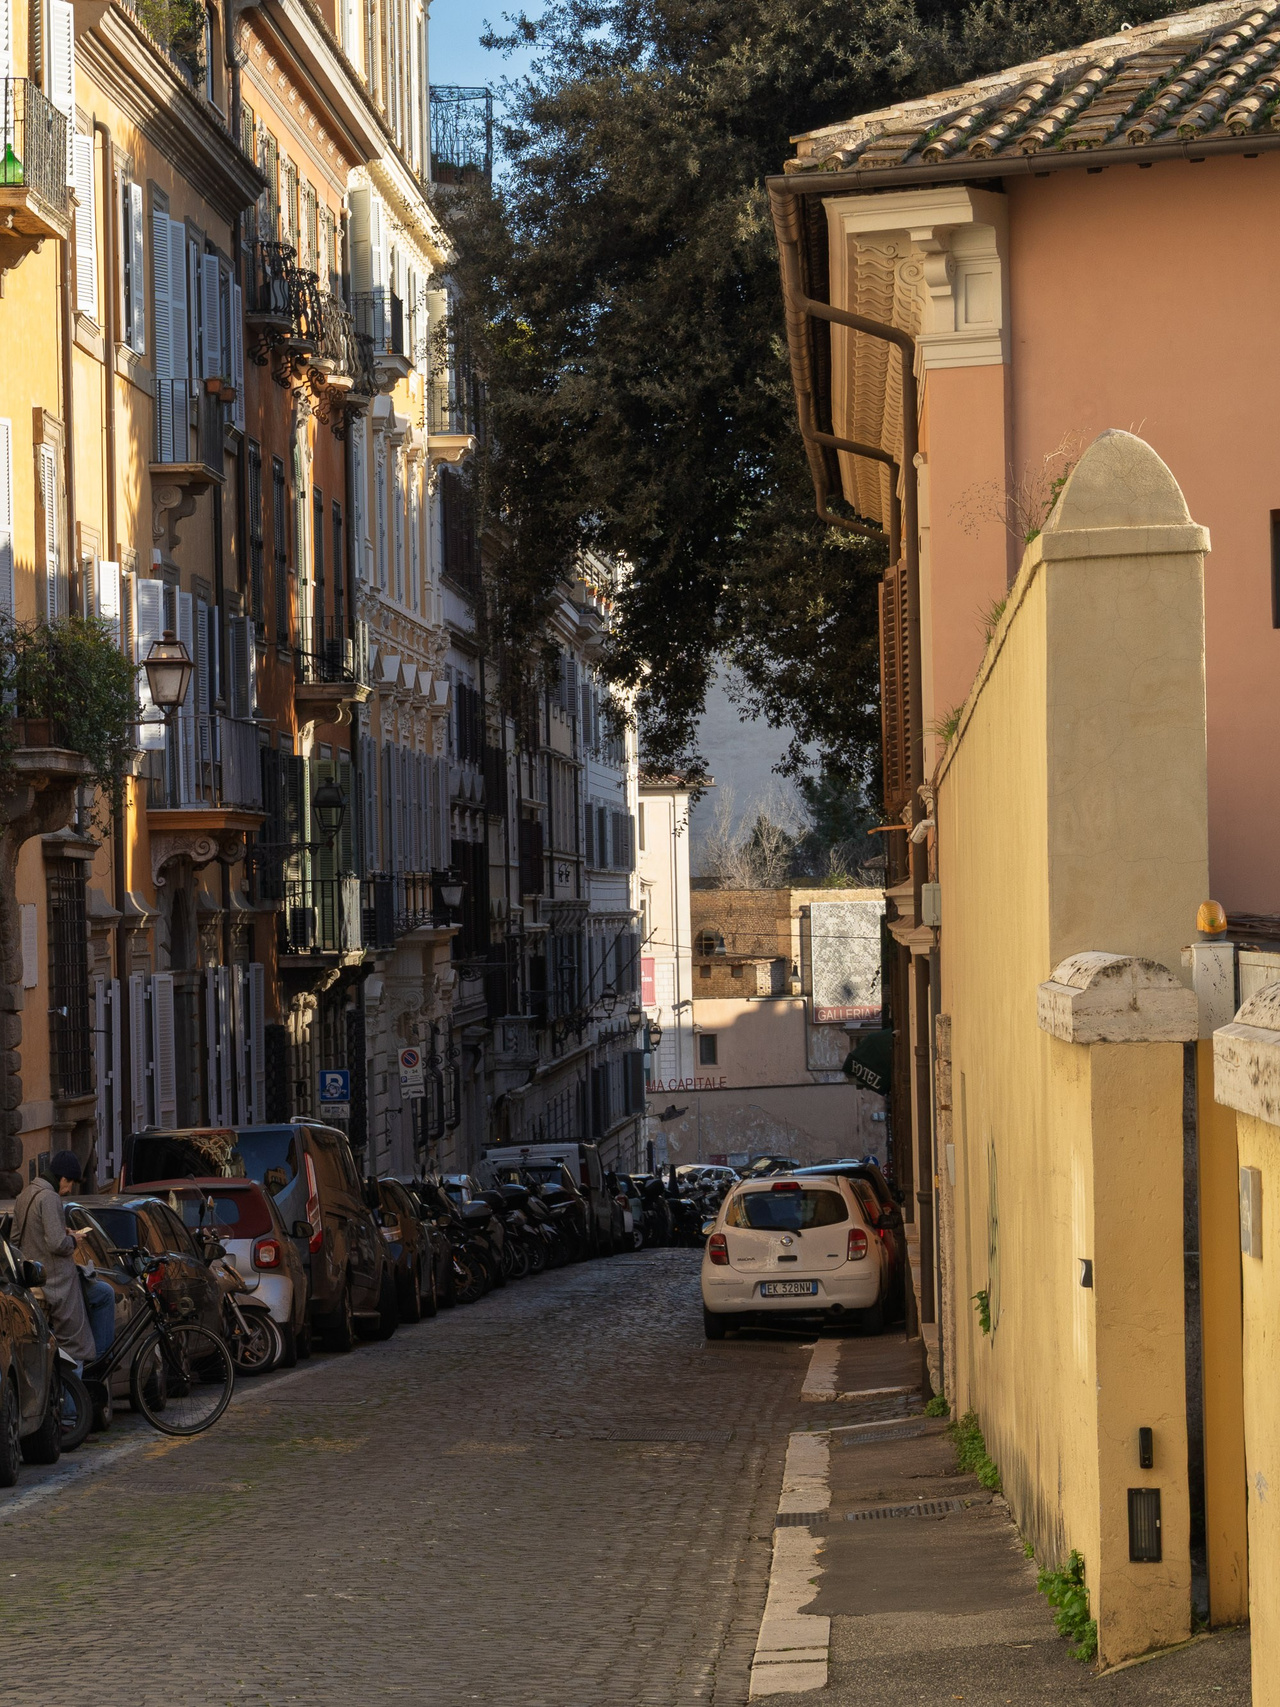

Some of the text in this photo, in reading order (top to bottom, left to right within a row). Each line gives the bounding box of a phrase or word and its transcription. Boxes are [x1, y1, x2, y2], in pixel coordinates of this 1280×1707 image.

[818, 1008, 871, 1021] GALLERIA
[668, 1076, 727, 1091] CAPITALE
[767, 1282, 811, 1294] EK 328NW
